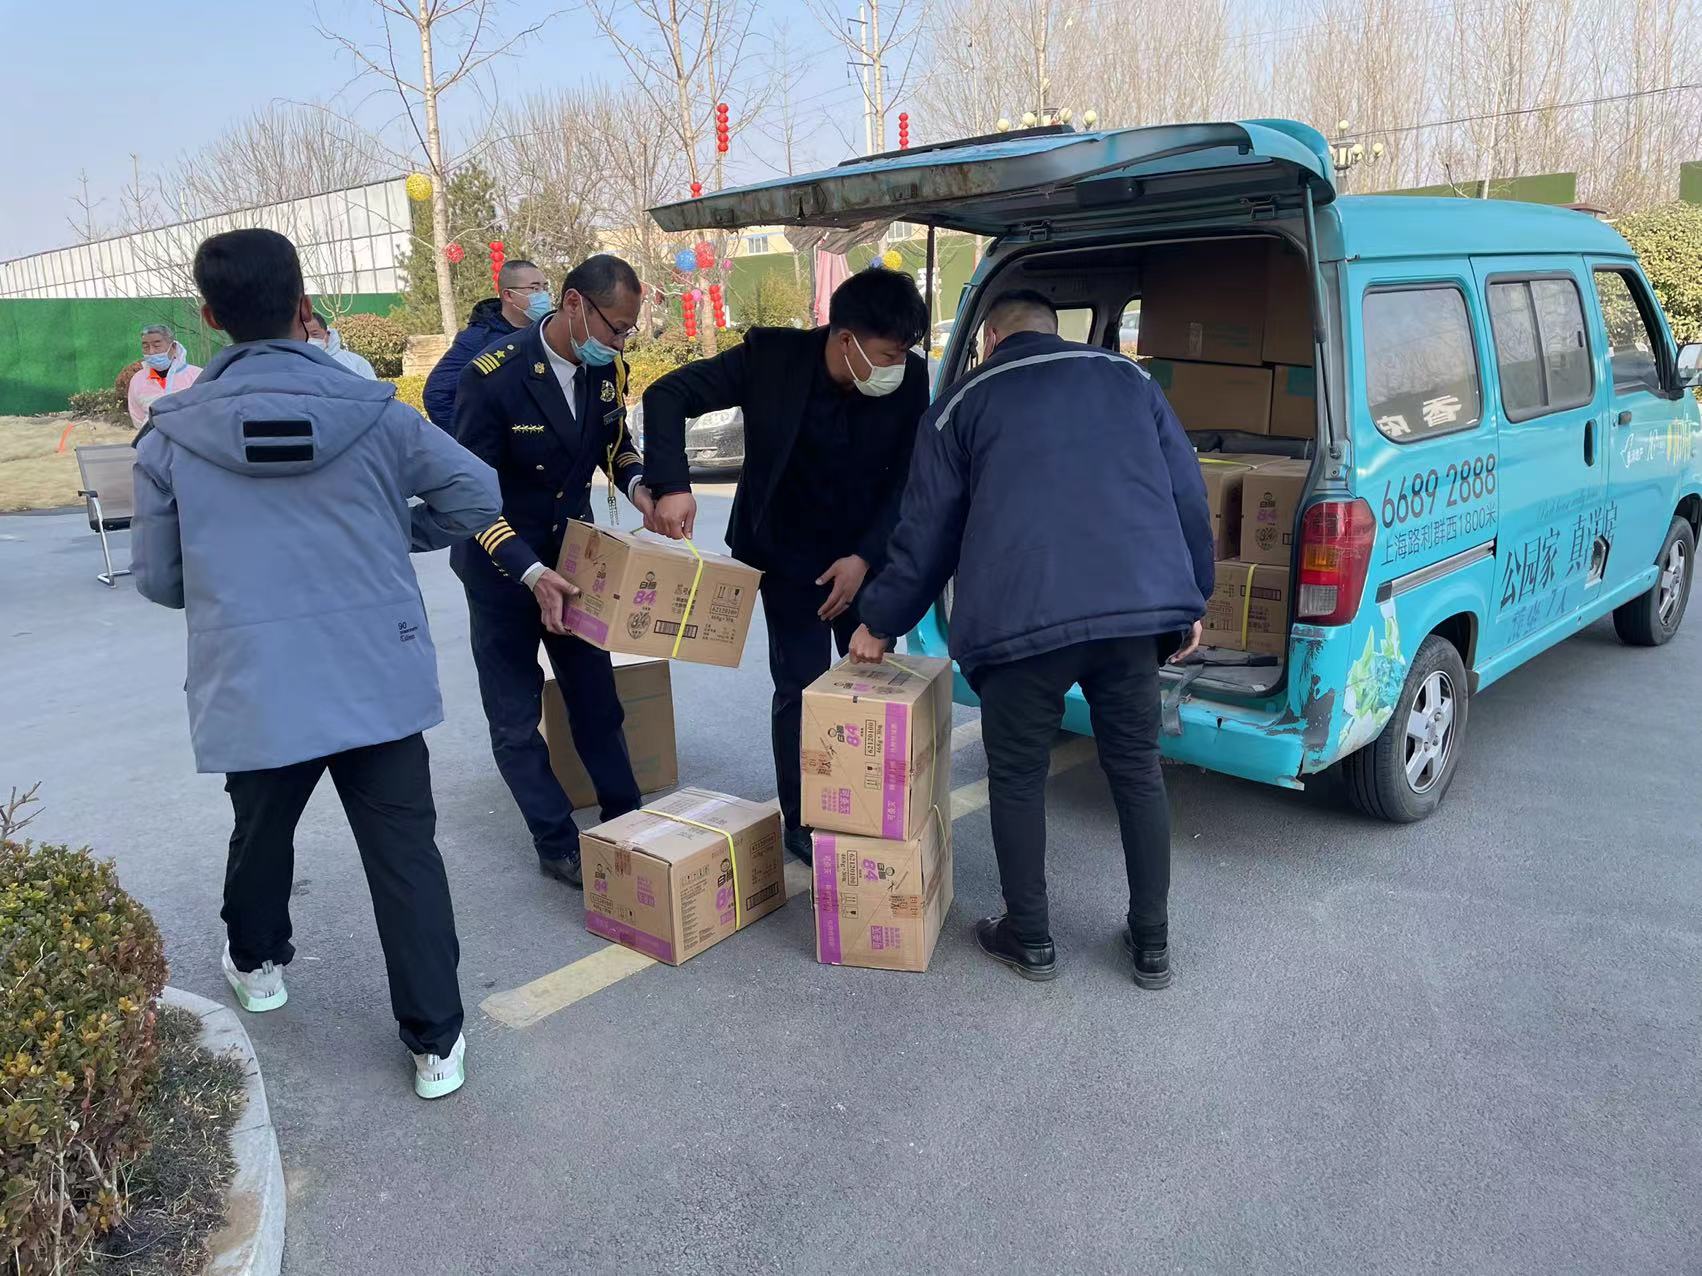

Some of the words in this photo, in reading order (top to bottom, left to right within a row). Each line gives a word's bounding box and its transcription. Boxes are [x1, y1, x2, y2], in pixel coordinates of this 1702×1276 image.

[1381, 468, 1439, 529] 6689
[1446, 453, 1496, 508] 2888
[1381, 503, 1497, 567] 上海路利群西1800米
[1500, 527, 1561, 609] 公园家
[632, 590, 657, 606] 84
[844, 722, 863, 748] 84
[867, 721, 875, 755] 62120100
[862, 859, 880, 882] 84
